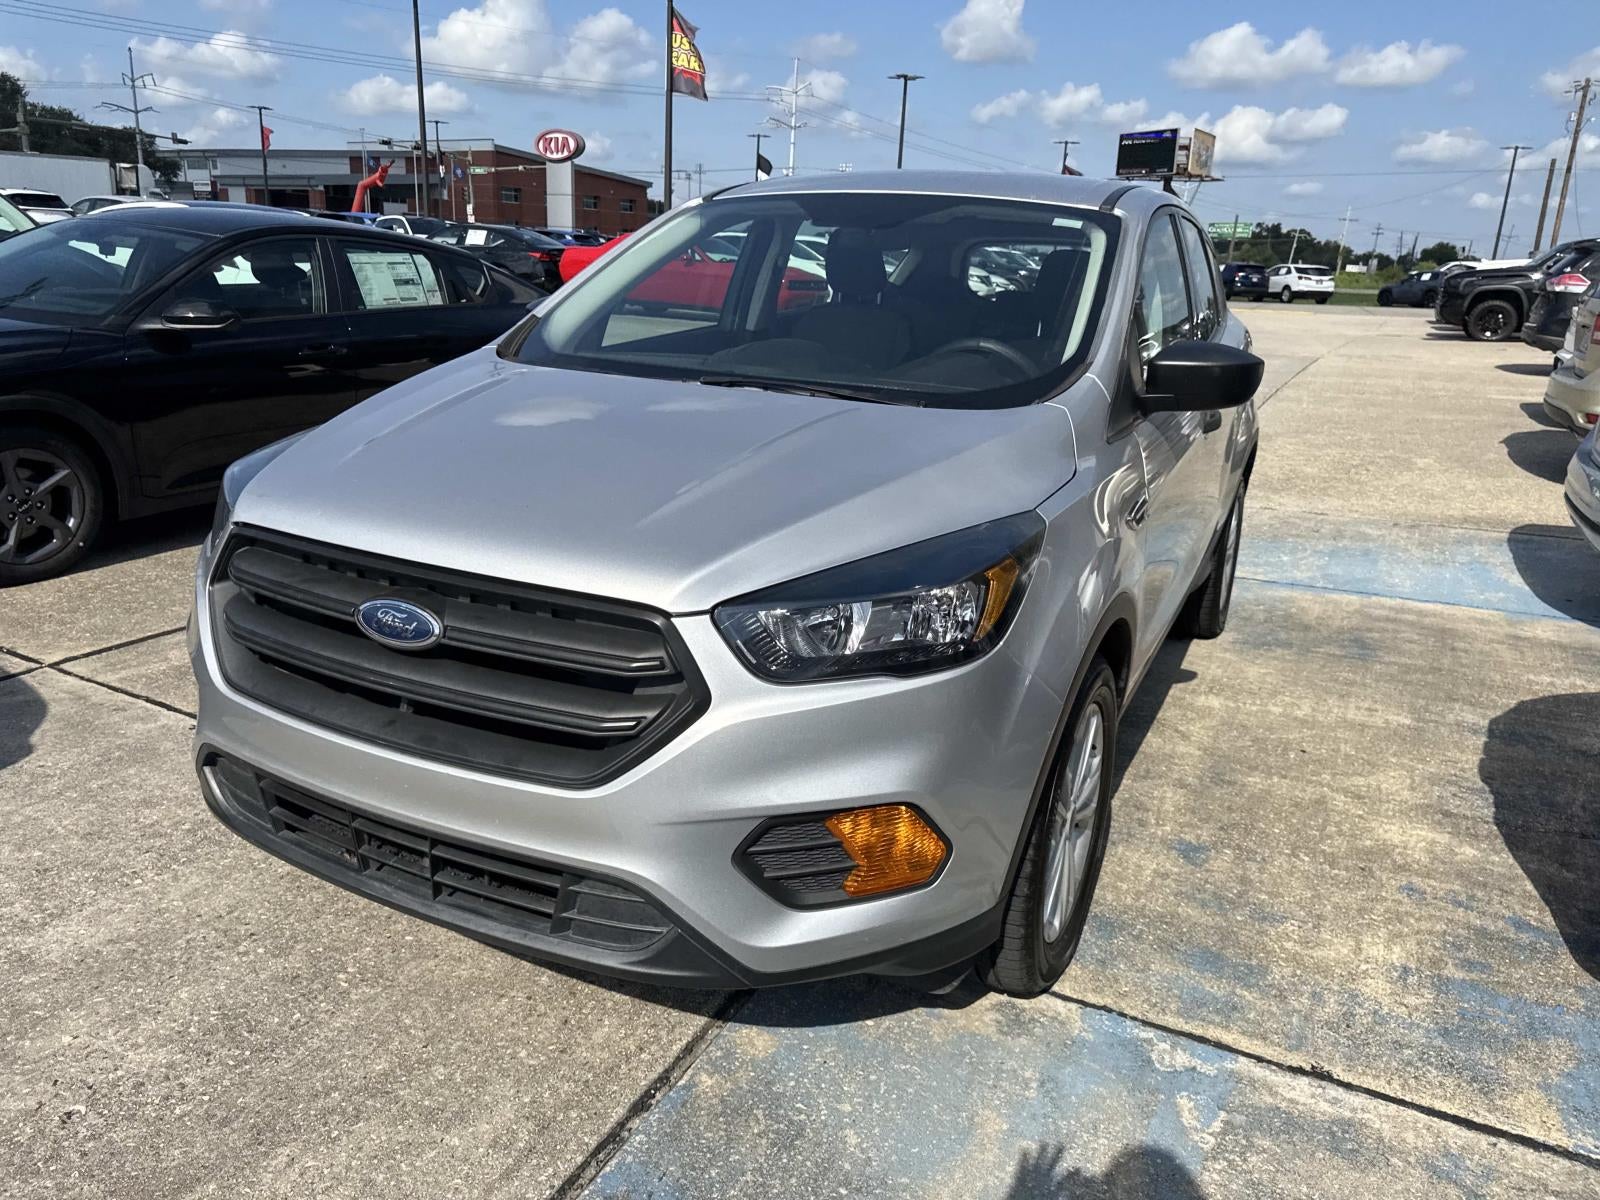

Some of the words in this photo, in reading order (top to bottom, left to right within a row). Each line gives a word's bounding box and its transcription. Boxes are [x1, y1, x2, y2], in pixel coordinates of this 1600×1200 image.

[672, 33, 695, 52] US
[542, 136, 571, 155] KIA
[373, 608, 418, 638] Ford
